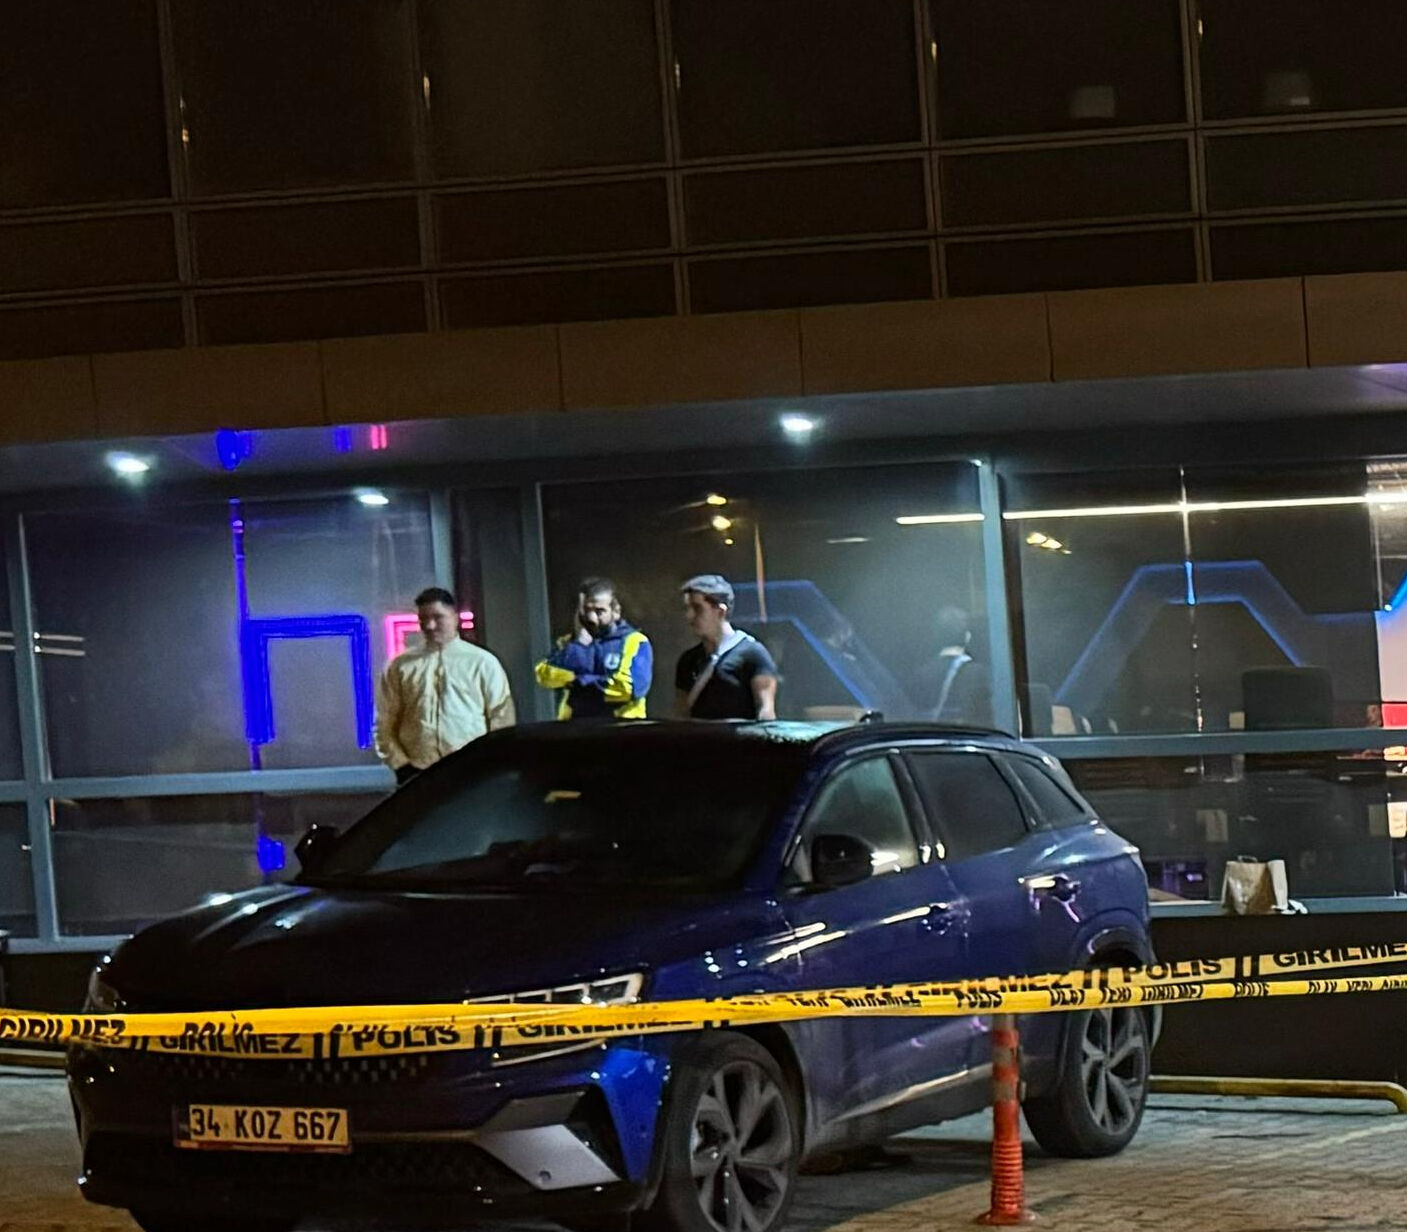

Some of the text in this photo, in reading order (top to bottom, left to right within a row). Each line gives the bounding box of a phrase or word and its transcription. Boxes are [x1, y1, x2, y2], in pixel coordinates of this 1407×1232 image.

[190, 1107, 342, 1142] 34 KOZ 667
